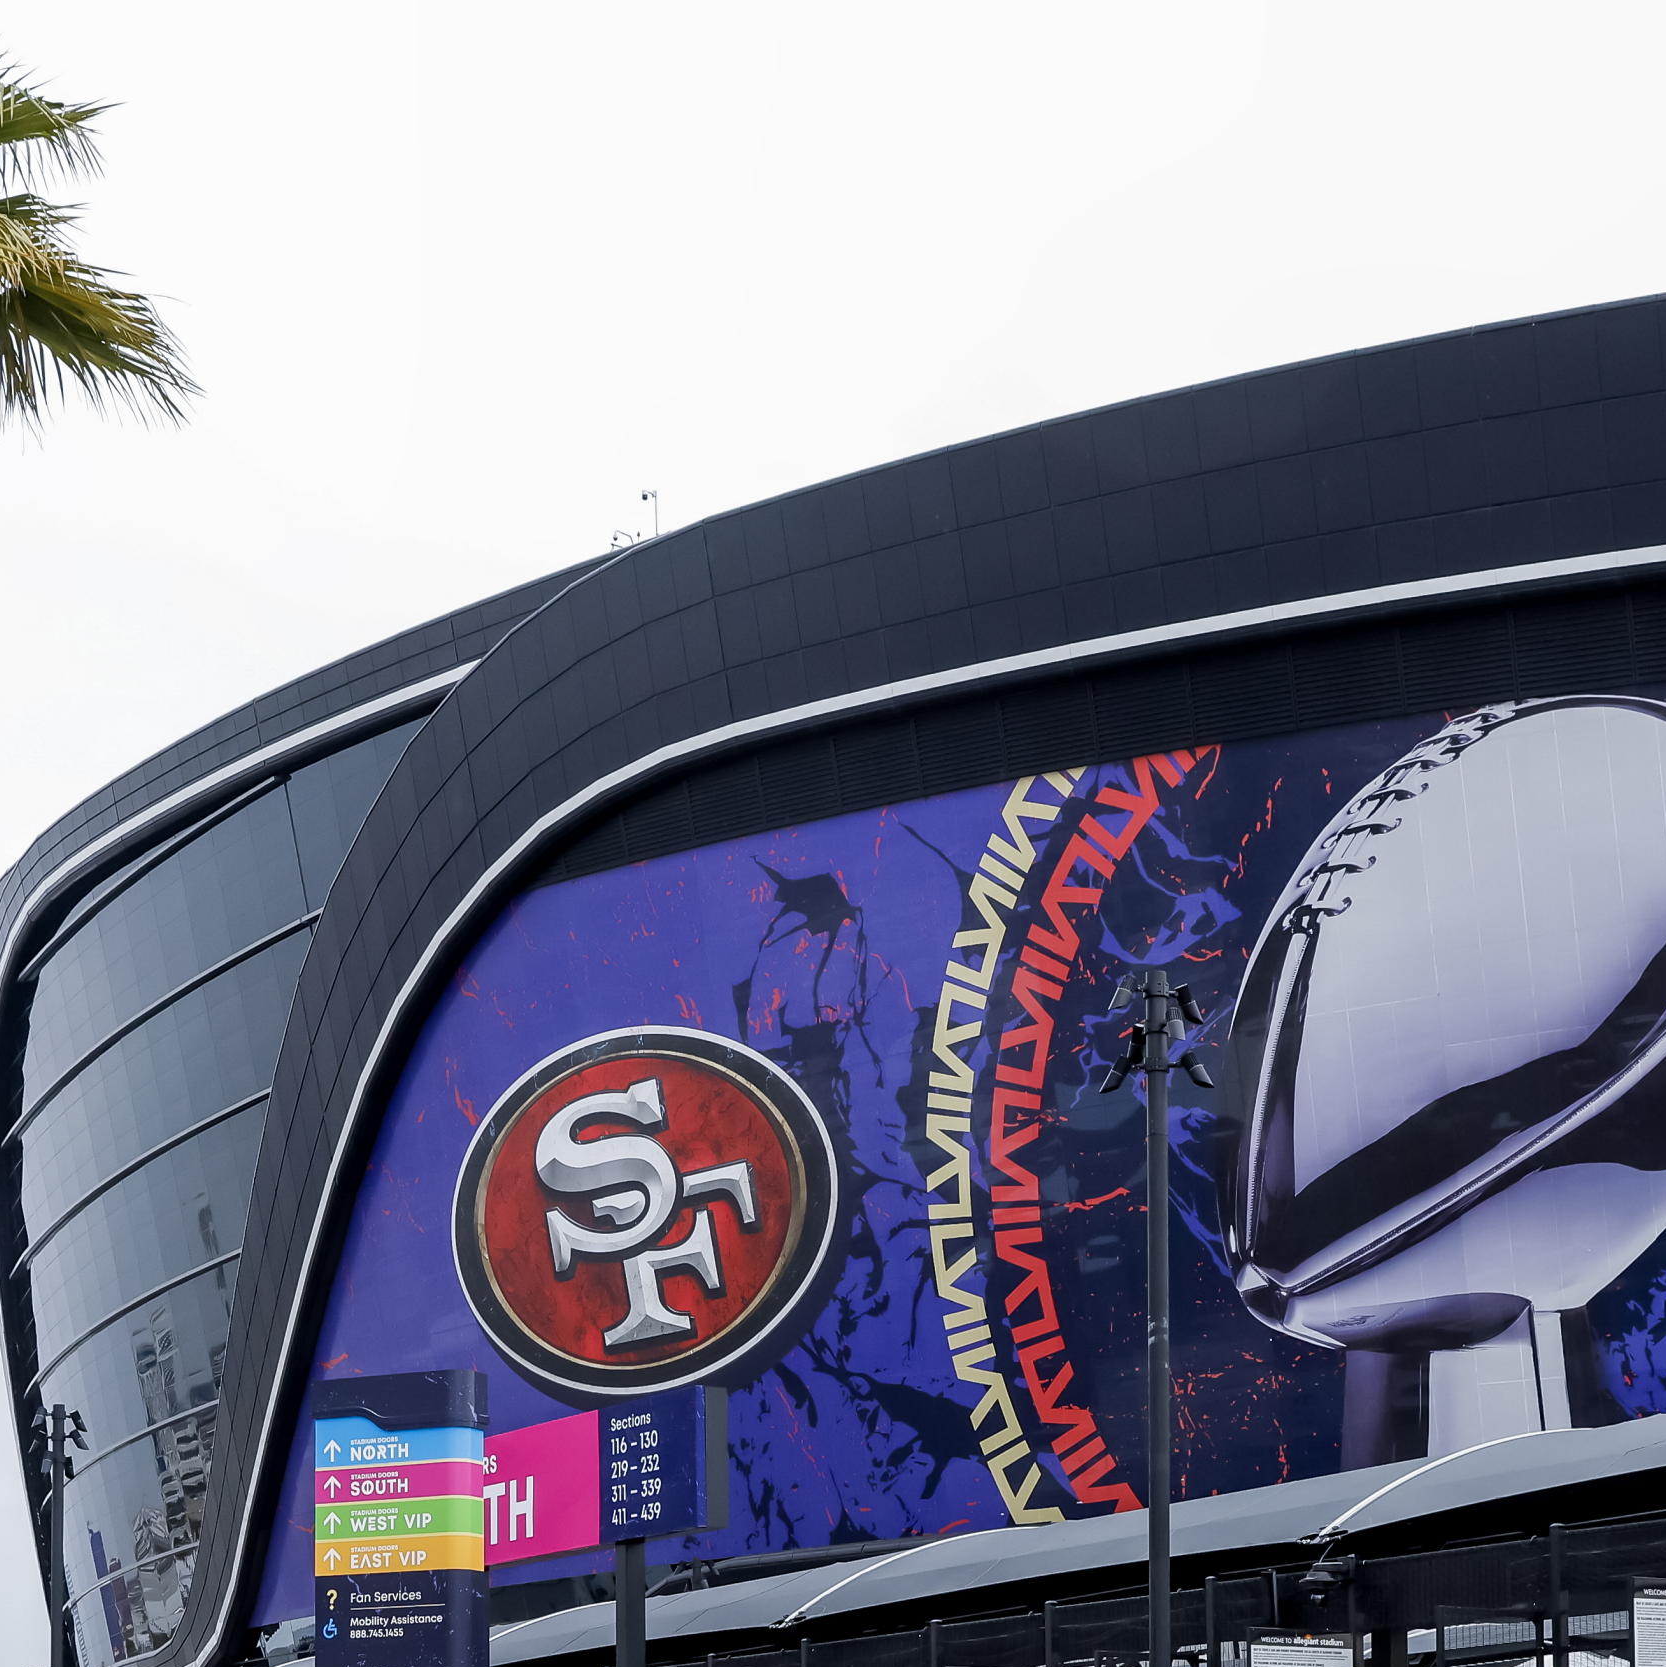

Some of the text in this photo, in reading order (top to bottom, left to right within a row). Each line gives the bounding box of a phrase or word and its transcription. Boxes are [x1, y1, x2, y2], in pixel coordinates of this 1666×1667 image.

[610, 1412, 651, 1431] Sections
[350, 1443, 409, 1462] NORTH
[611, 1438, 627, 1456] 116
[639, 1430, 658, 1449] 130
[611, 1461, 628, 1479] 219
[640, 1453, 660, 1473] 232
[350, 1478, 409, 1496] SOUTH
[611, 1484, 627, 1503] 311
[641, 1477, 662, 1498] 339
[350, 1513, 432, 1532] WEST VIP
[611, 1507, 627, 1526] 411
[640, 1501, 661, 1521] 439
[350, 1551, 427, 1569] EAST VIP
[350, 1590, 422, 1603] Fan Services
[350, 1614, 443, 1628] Mobility Assistance
[350, 1628, 404, 1639] 888.745.1455
[1293, 1636, 1319, 1647] allegiant
[1320, 1639, 1344, 1647] stadium
